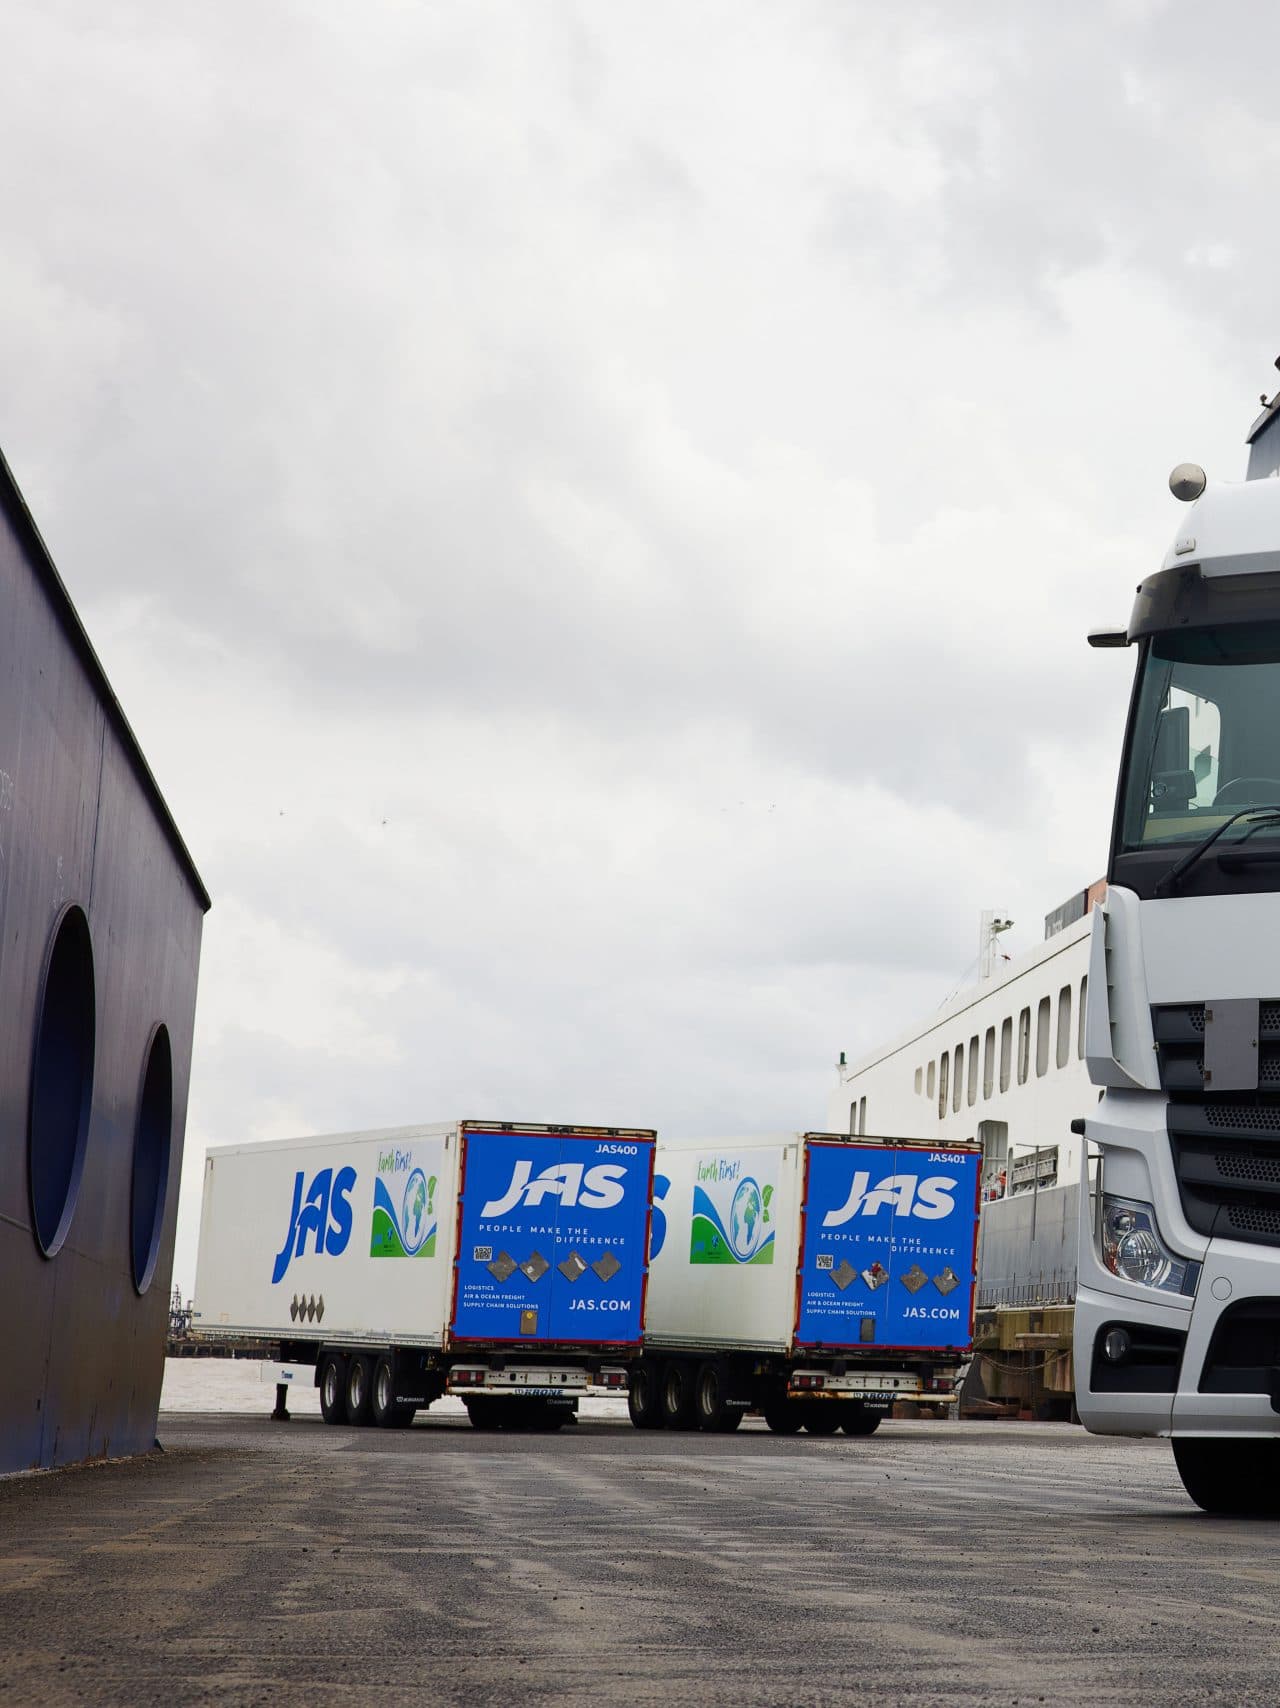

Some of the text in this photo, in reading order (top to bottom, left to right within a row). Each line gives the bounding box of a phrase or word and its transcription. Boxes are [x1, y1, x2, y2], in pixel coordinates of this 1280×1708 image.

[595, 1143, 638, 1156] JAS400
[927, 1152, 967, 1165] JAS401
[480, 1160, 628, 1218] JAS
[822, 1171, 959, 1227] JAS
[271, 1165, 358, 1284] JAS
[479, 1224, 588, 1235] PEOPLE MAKE THE
[556, 1236, 626, 1245] DIFFERENCE
[821, 1233, 921, 1245] PEOPLE MAKE THE
[891, 1245, 956, 1255] DIFFERENCE
[569, 1299, 631, 1311] JAS.COM
[902, 1307, 961, 1319] JAS.COM
[525, 1388, 564, 1396] KRONE
